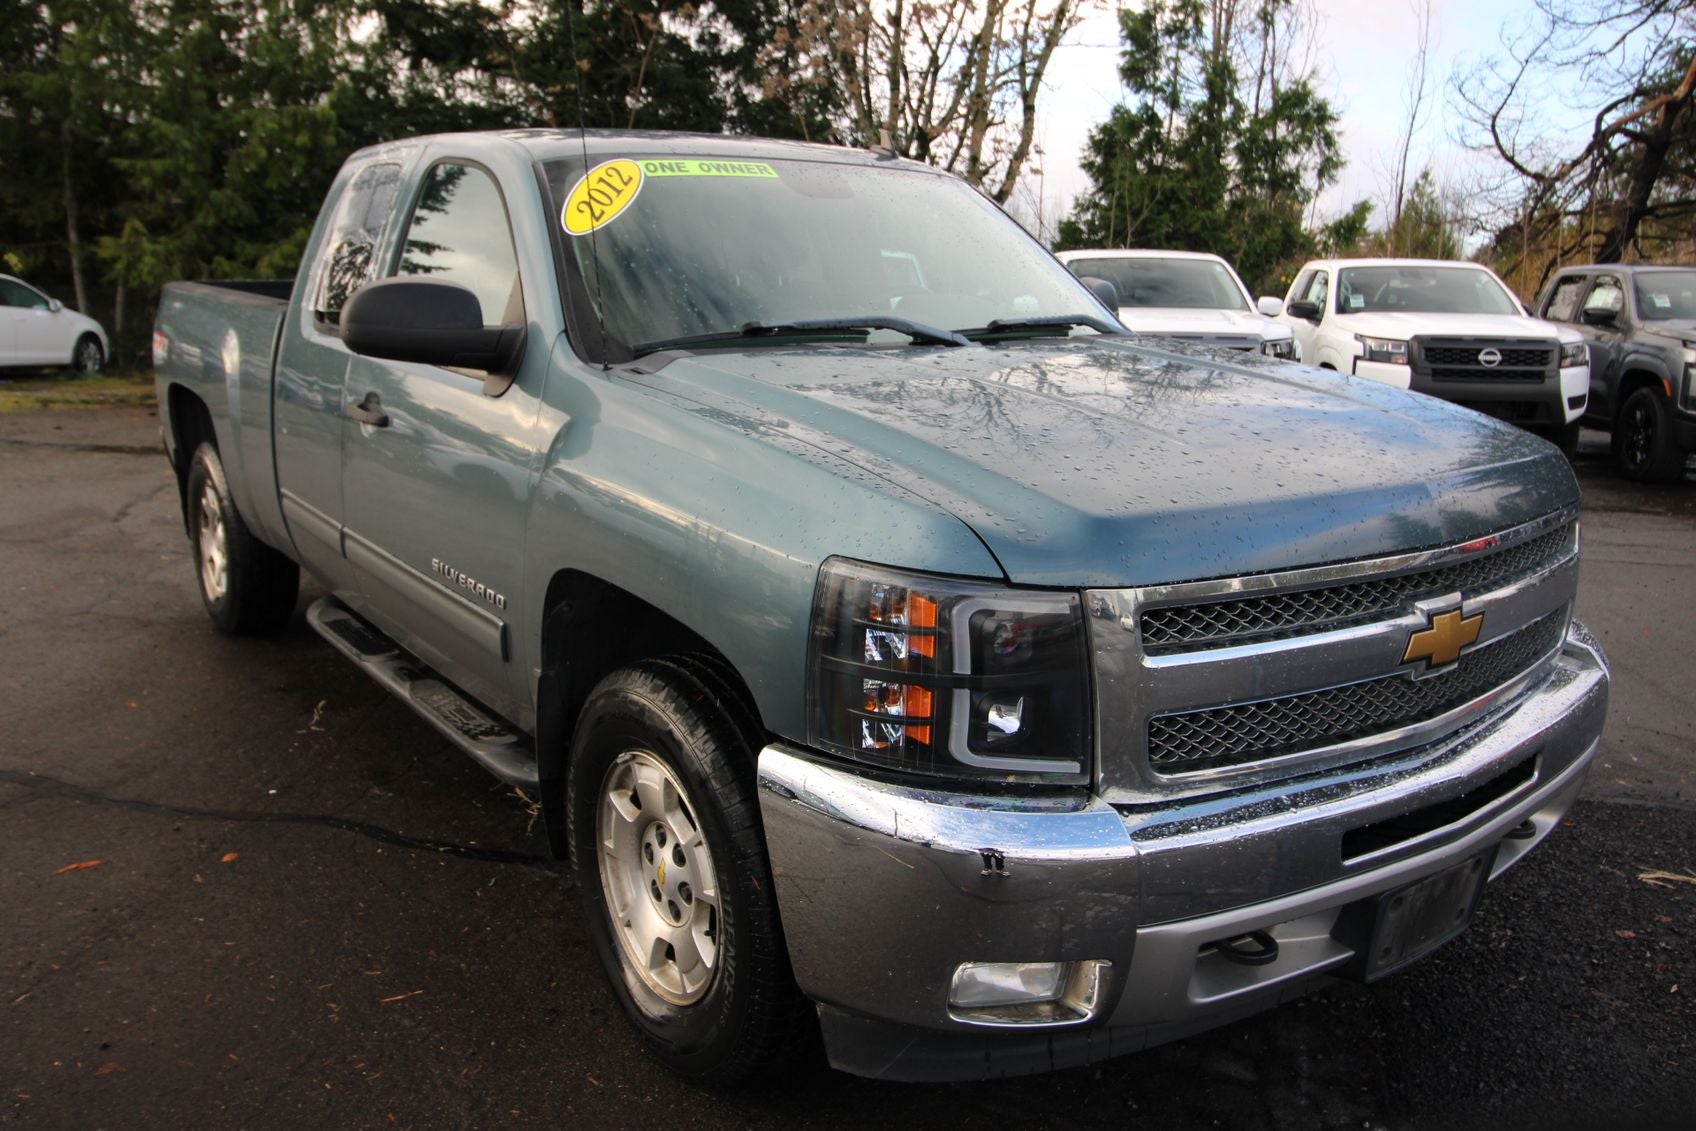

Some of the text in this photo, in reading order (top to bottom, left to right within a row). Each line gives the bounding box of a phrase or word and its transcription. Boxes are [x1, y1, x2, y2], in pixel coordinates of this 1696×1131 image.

[576, 166, 633, 222] 2012
[645, 161, 772, 175] ONE OWNER
[431, 557, 505, 609] SILVERADO
